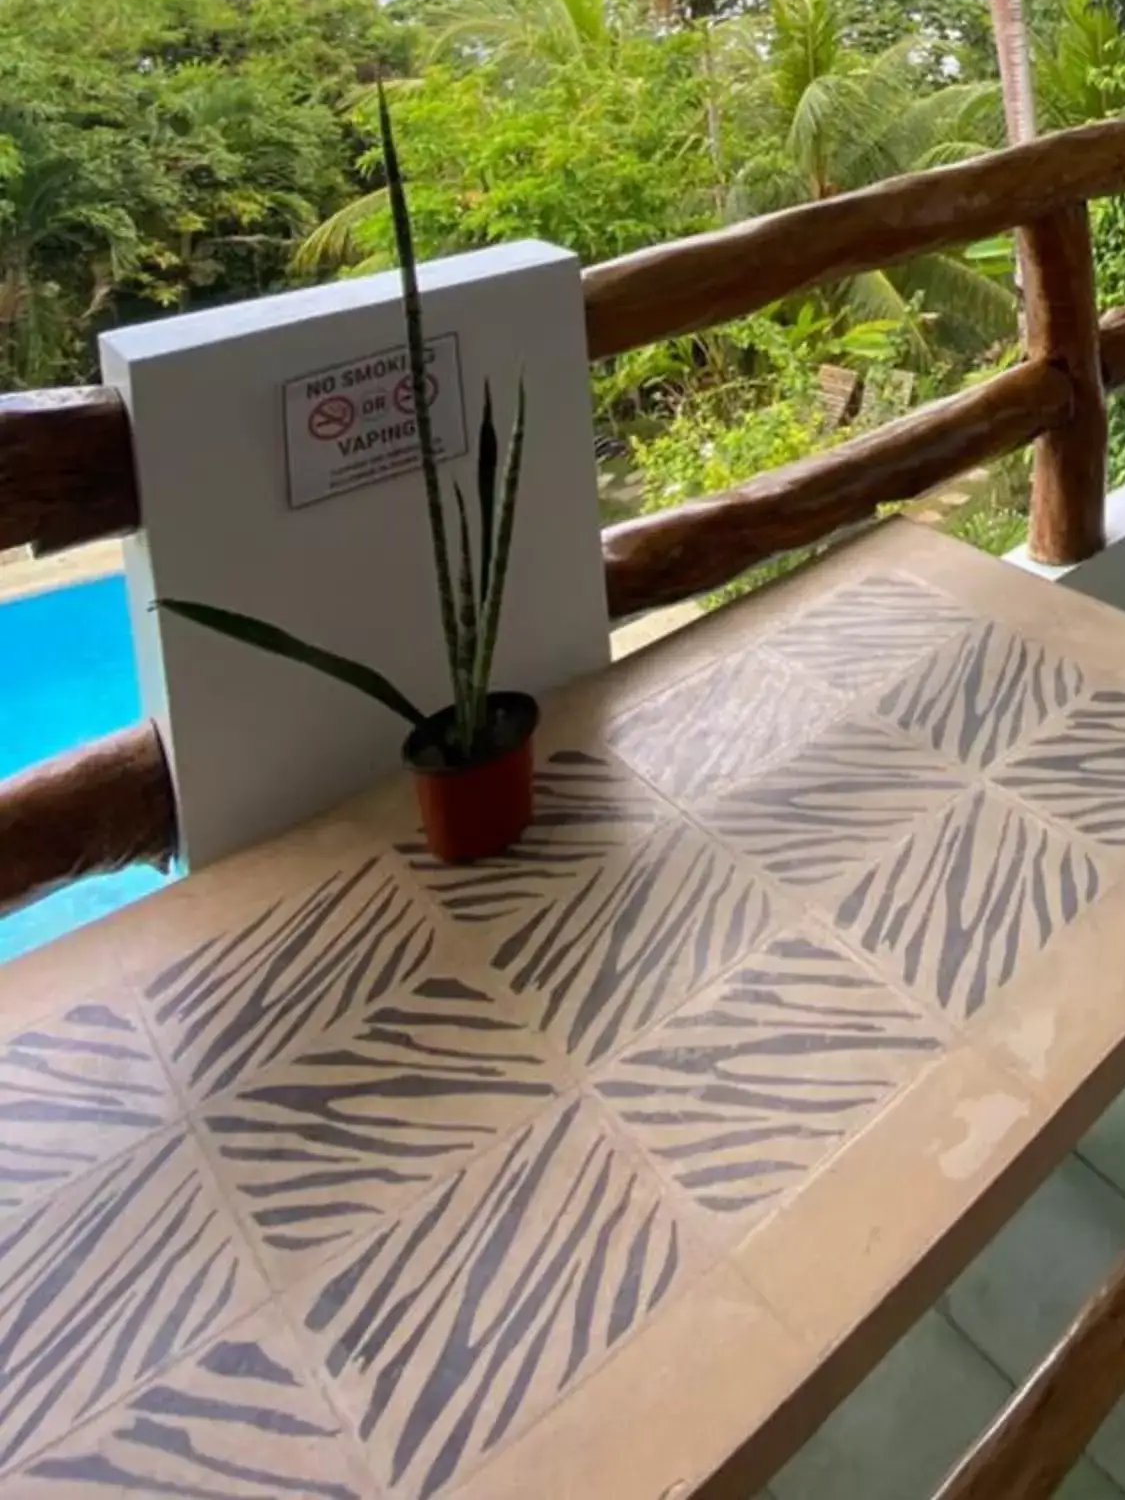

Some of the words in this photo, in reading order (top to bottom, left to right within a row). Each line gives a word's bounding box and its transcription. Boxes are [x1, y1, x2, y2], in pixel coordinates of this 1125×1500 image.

[306, 376, 336, 399] NO
[342, 348, 436, 388] SMOKIG
[362, 396, 386, 415] OR
[338, 420, 416, 457] VAPING
